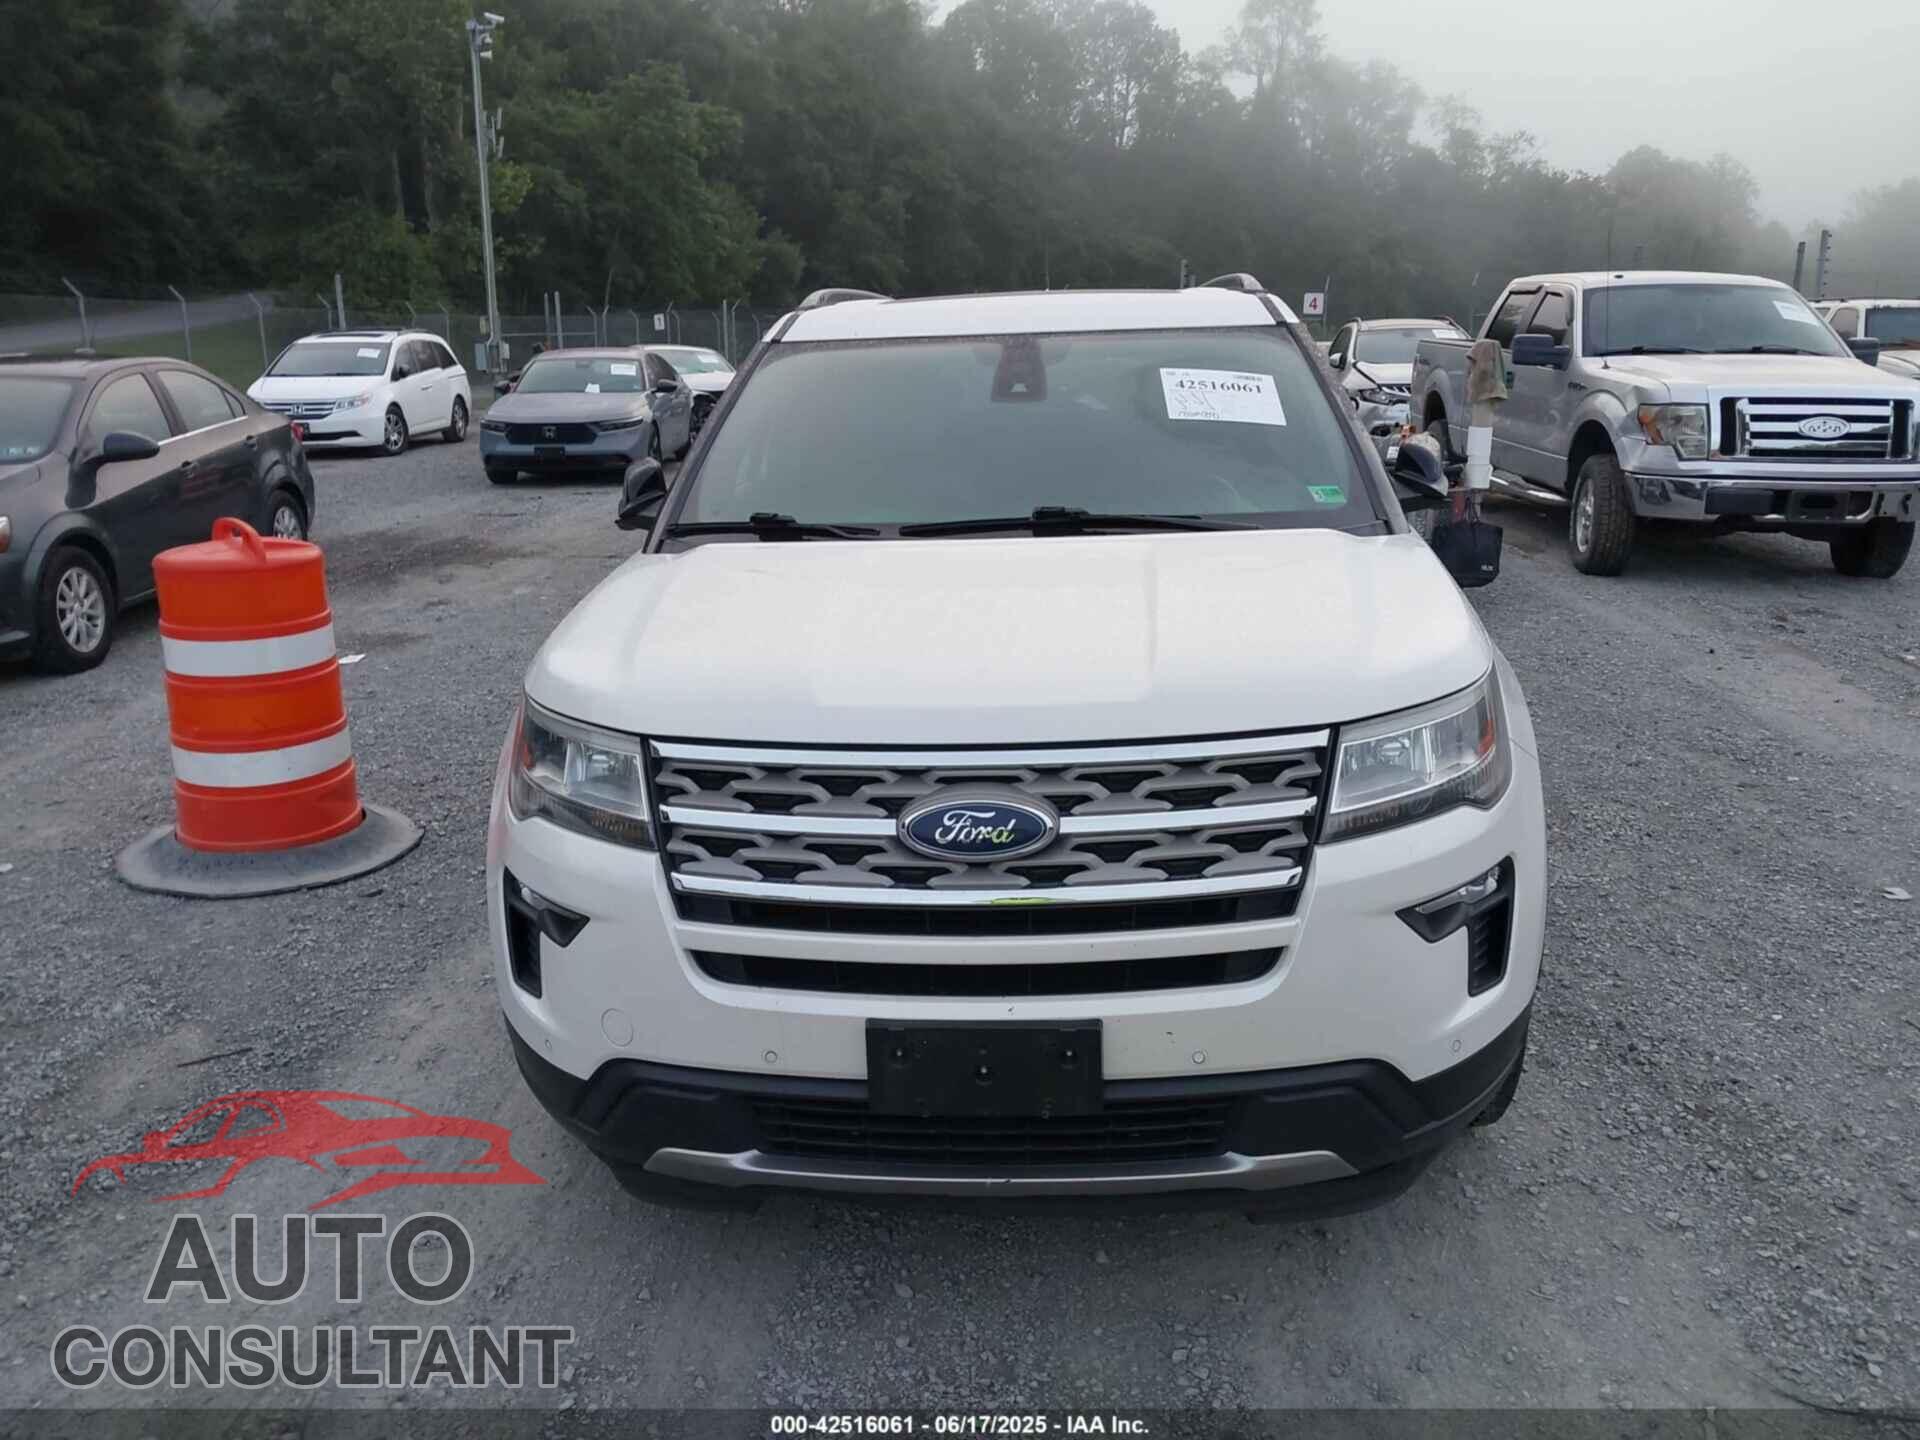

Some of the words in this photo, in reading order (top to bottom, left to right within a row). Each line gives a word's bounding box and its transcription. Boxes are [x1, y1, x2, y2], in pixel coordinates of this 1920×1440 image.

[1309, 296, 1318, 311] 4
[1175, 379, 1263, 394] 42516061
[934, 809, 1017, 844] Ford
